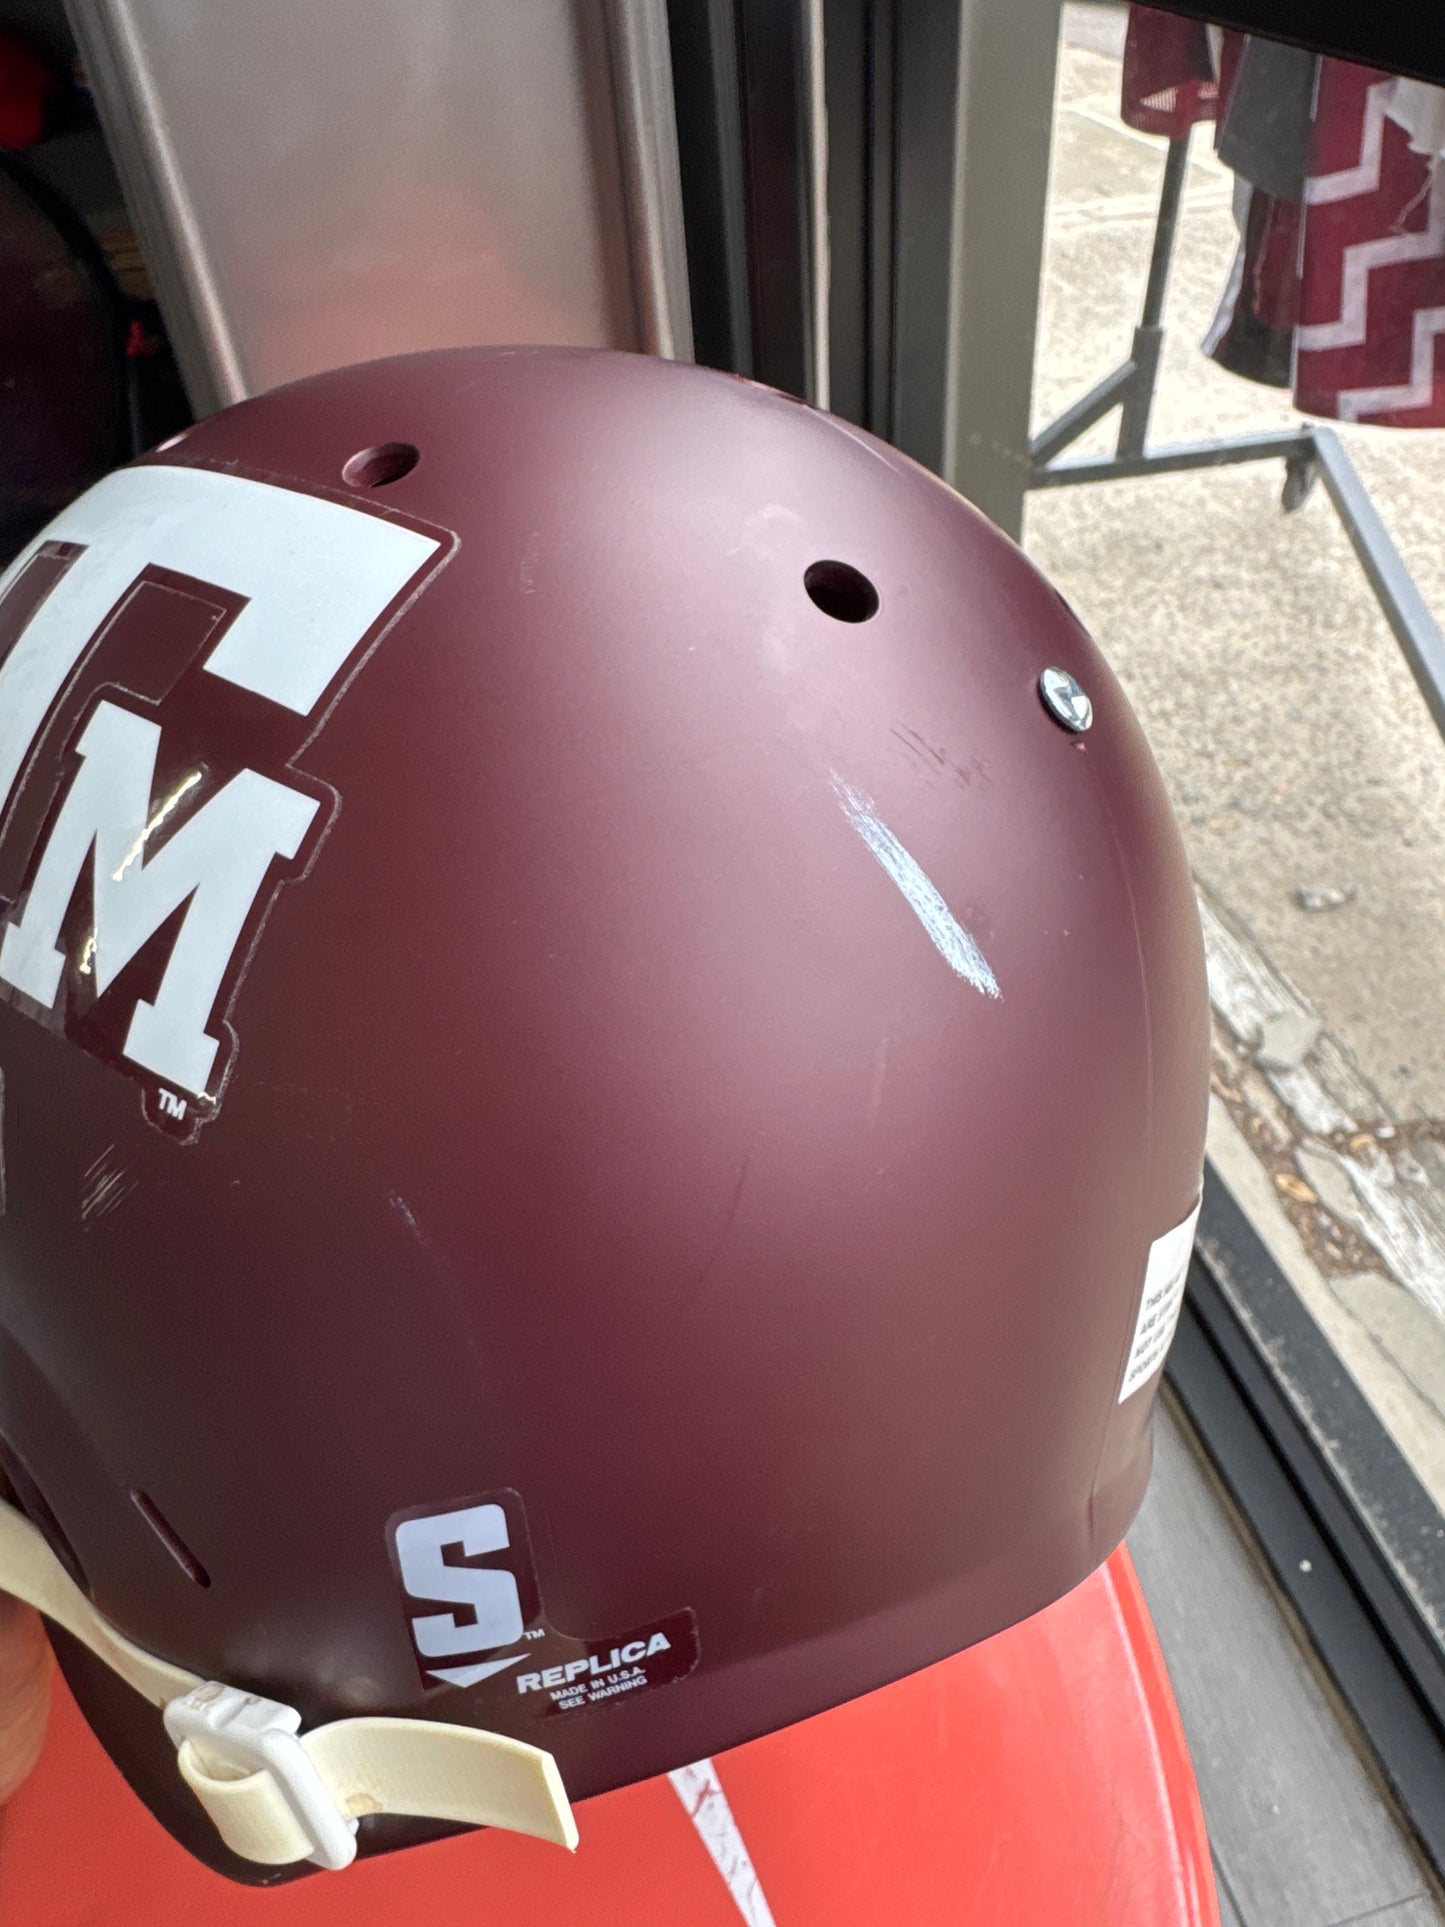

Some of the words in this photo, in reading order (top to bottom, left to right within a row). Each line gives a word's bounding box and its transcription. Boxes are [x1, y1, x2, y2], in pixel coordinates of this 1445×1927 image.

[158, 1087, 188, 1120] TM
[395, 1503, 525, 1658] S
[523, 1628, 546, 1641] TM
[516, 1631, 672, 1695] REPLICA
[550, 1683, 588, 1701] MADE
[590, 1678, 605, 1689] IN
[608, 1666, 646, 1684] U.S.A.
[558, 1695, 586, 1710] SEE
[587, 1675, 648, 1702] WARNING
